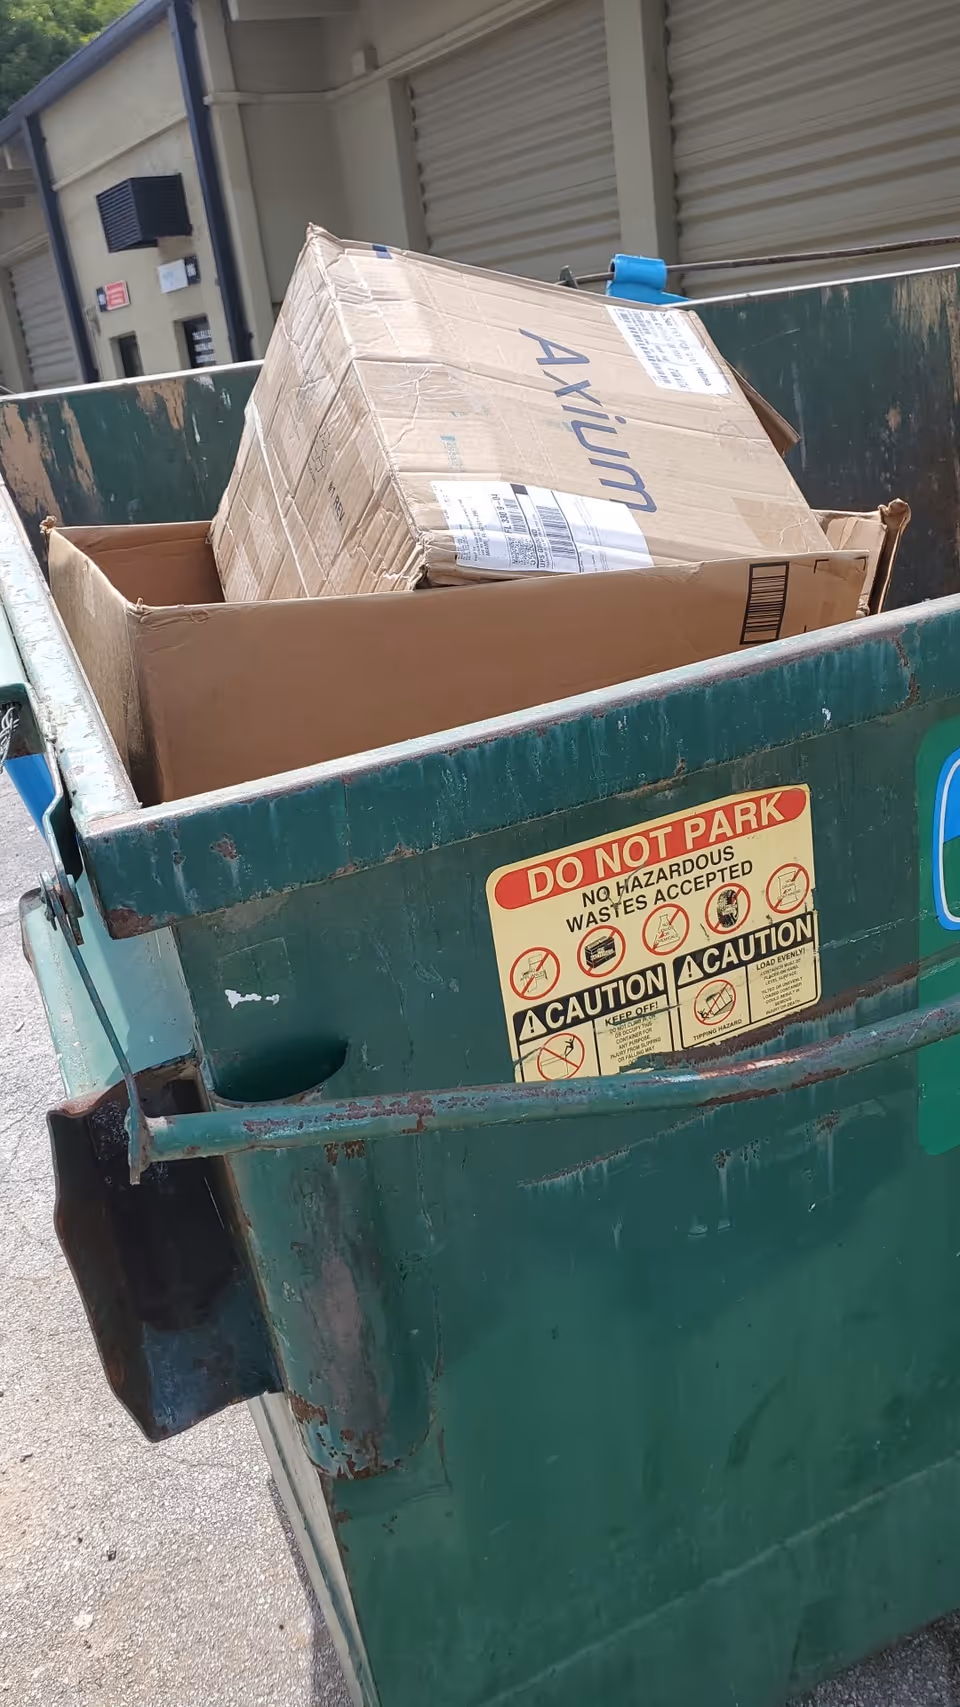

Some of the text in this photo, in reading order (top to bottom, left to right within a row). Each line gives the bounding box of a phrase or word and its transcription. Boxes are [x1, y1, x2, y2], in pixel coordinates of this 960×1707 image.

[518, 327, 657, 513] Axium
[498, 511, 511, 524] 330
[527, 792, 785, 900] DO NOT PARK
[582, 845, 735, 907] NO HAZARDOUS
[566, 860, 753, 933] WASTES ACCEPTED
[702, 914, 812, 974] CAUTION
[756, 958, 776, 971] LOAD
[545, 966, 665, 1029] CAUTION
[604, 1001, 659, 1026] KEEP OFF!
[614, 1031, 622, 1039] OR
[622, 1025, 641, 1036] OCCUPY
[616, 1026, 653, 1044] CONTAINER FOR
[693, 1018, 743, 1041] TIPPING HAZARD
[618, 1055, 625, 1063] OR
[625, 1049, 645, 1060] FALLING
[619, 1041, 628, 1050] ANY
[627, 1043, 641, 1053] FROM
